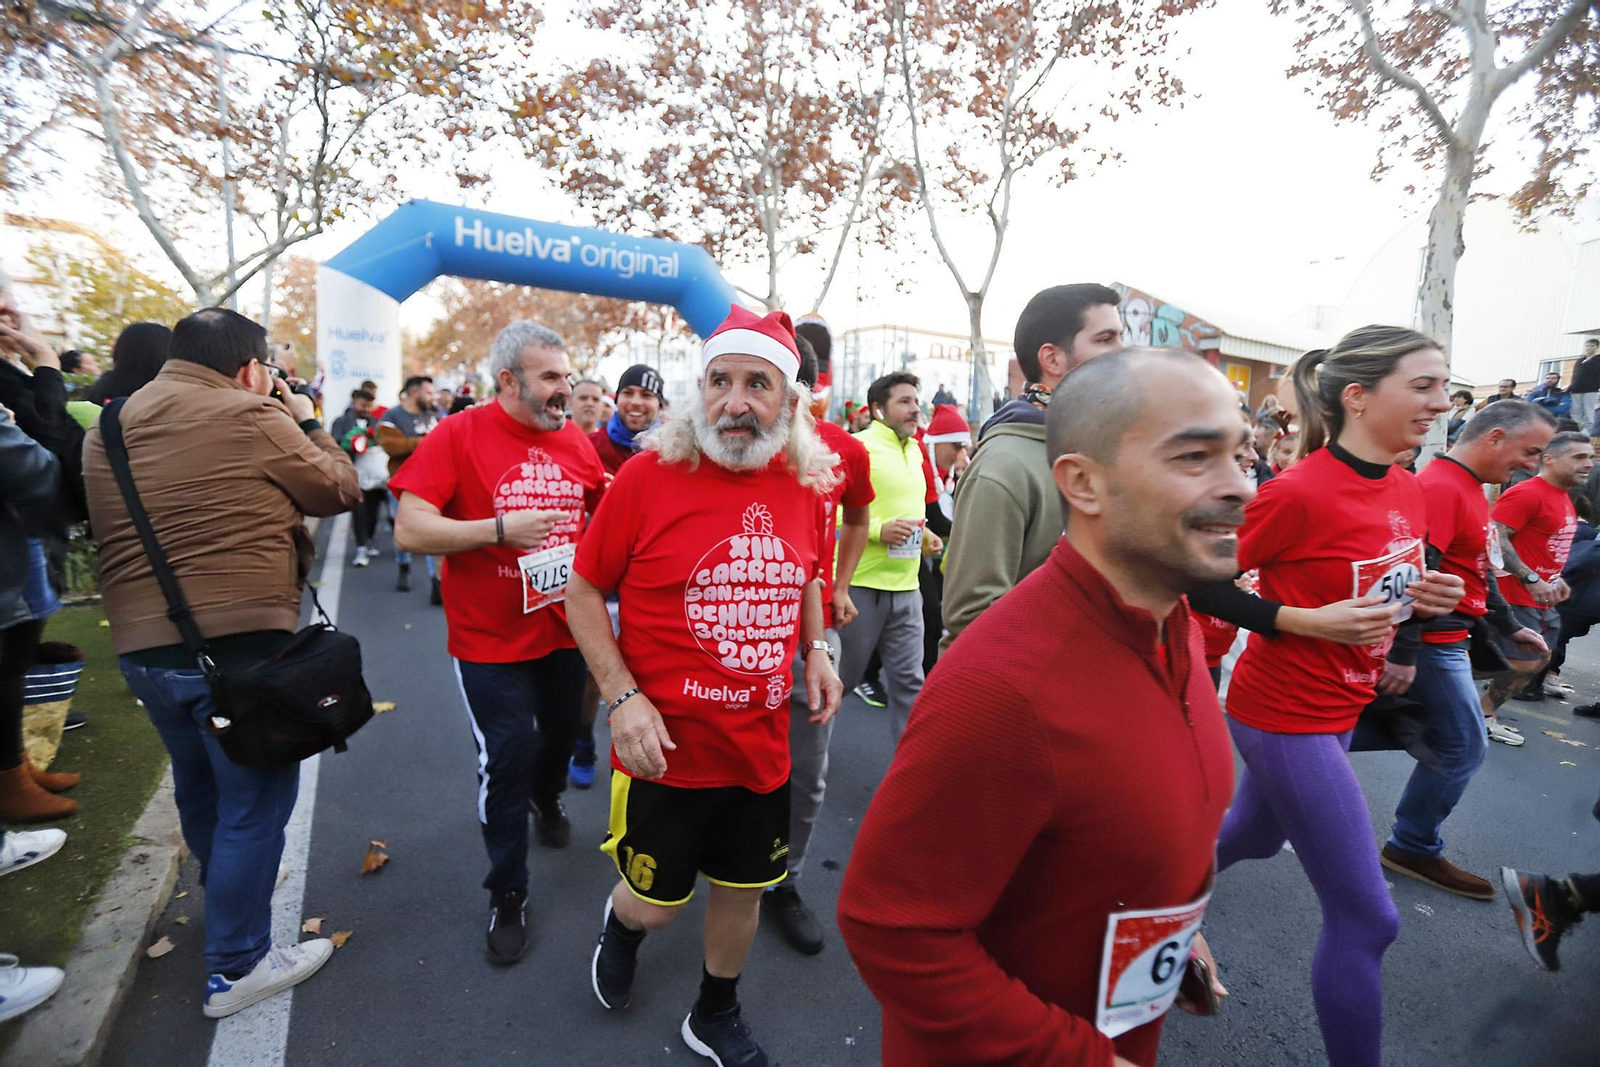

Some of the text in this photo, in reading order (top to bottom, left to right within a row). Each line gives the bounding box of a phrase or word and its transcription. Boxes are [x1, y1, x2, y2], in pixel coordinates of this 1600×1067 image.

[580, 241, 679, 279] original
[520, 462, 562, 481] XIII
[499, 478, 584, 499] CARRERA
[728, 535, 785, 561] XIII
[695, 559, 806, 587] CARRERA
[686, 584, 733, 602] SAN
[688, 603, 718, 622] DE
[694, 622, 728, 642] 30
[728, 628, 747, 642] DE
[717, 640, 785, 670] 2023
[623, 845, 658, 891] 16
